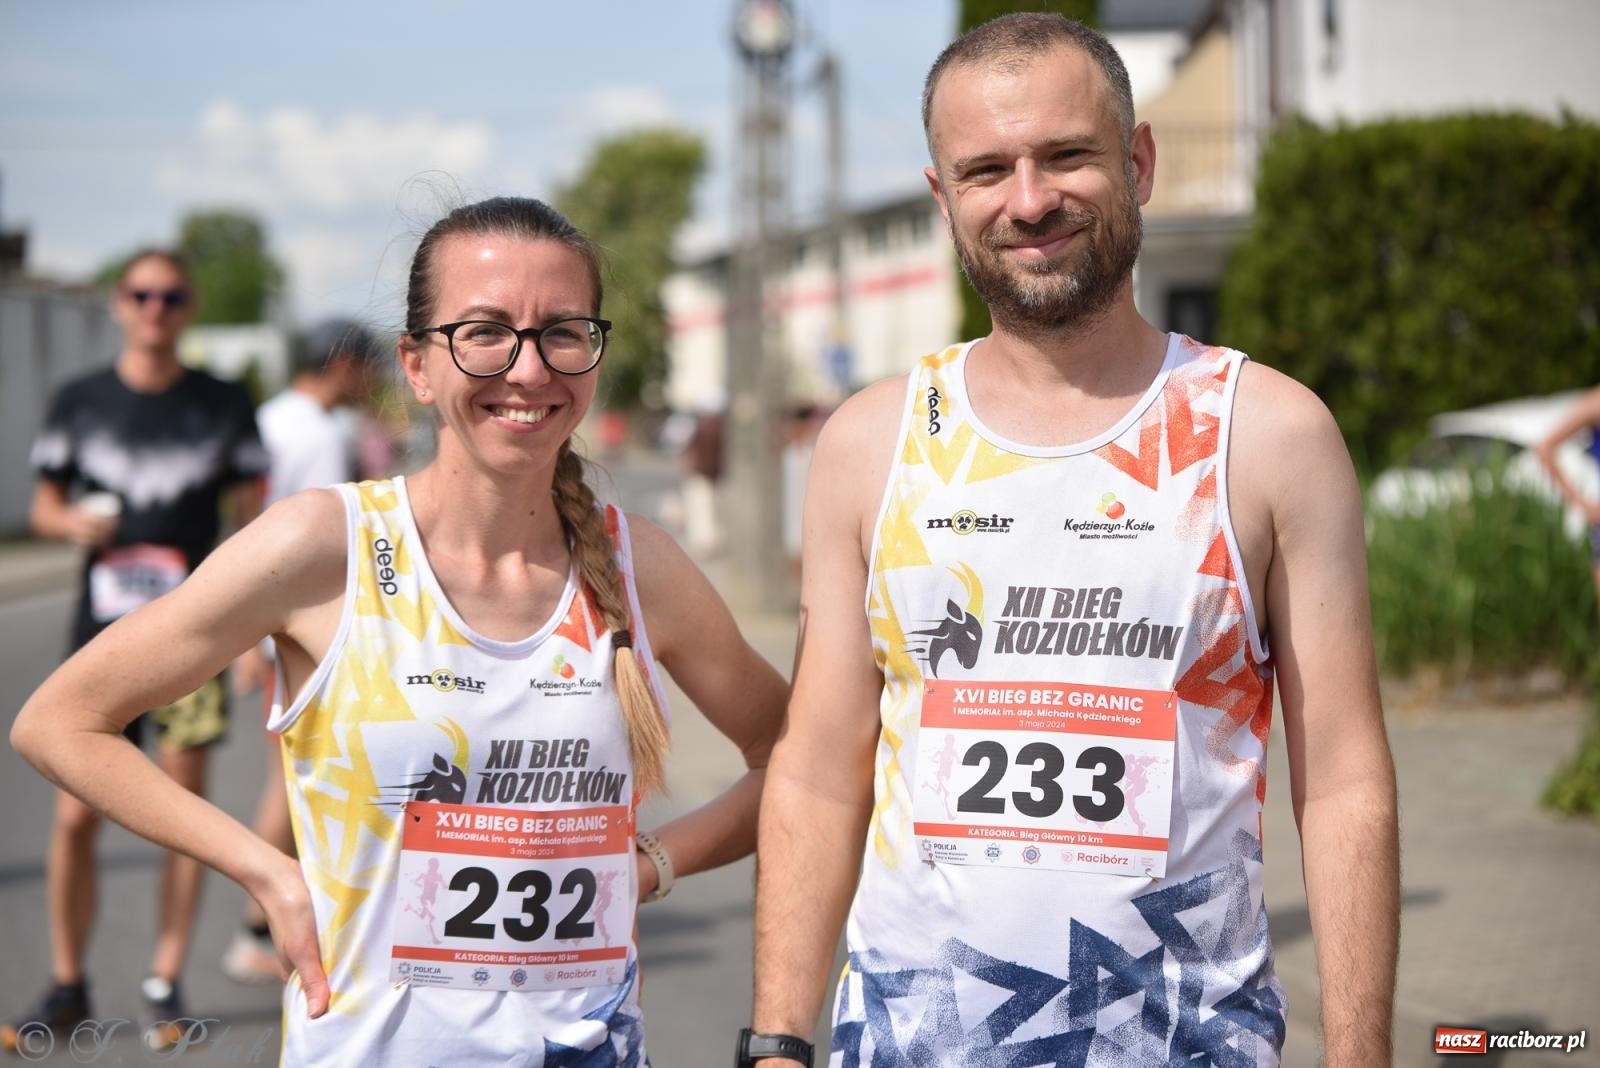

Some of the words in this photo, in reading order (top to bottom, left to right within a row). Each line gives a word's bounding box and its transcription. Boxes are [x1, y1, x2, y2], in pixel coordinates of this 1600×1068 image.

[1063, 518, 1155, 533] Kędzierzyn-Koźle
[374, 538, 398, 595] deep
[1001, 586, 1050, 618] XII
[1050, 586, 1123, 619] BIEG
[992, 617, 1184, 661] KOZIOŁKÓW
[953, 688, 985, 704] XVI
[988, 688, 1027, 705] BIEG
[1030, 689, 1064, 705] BEZ
[1067, 691, 1144, 712] GRANIC
[958, 707, 1001, 716] MEMORIAŁ
[1002, 708, 1015, 716] im.
[1017, 710, 1036, 718] asp.
[1037, 709, 1074, 719] Michała
[1076, 711, 1142, 726] Kędzierskiego
[1046, 721, 1065, 729] 2024
[485, 739, 524, 769] XII
[525, 738, 591, 769] BIEG
[476, 766, 627, 804] KOZIOŁKÓW
[957, 740, 1126, 822] 233
[435, 811, 472, 829] XVI
[474, 814, 519, 832] BIEG
[522, 818, 554, 833] BEZ
[556, 815, 608, 833] GRANIC
[441, 831, 490, 842] MEMORIAŁ
[491, 834, 507, 844] im.
[508, 837, 528, 847] asp.
[529, 836, 561, 845] Michała
[967, 828, 1018, 838] KATEGORIA:
[1020, 831, 1039, 841] Bieg
[1041, 832, 1075, 843] Główny
[1078, 834, 1087, 843] 10
[1088, 835, 1103, 843] km
[517, 849, 537, 857] maja
[933, 843, 957, 851] POLICJA
[1077, 852, 1129, 866] Racibórz
[444, 866, 597, 942] 232
[454, 952, 508, 962] KATEGORIA:
[508, 955, 526, 964] Bieg
[527, 954, 558, 964] Główny
[558, 953, 566, 961] 10
[567, 952, 579, 961] km
[413, 966, 442, 974] POLICJA
[557, 969, 597, 980] Racibórz
